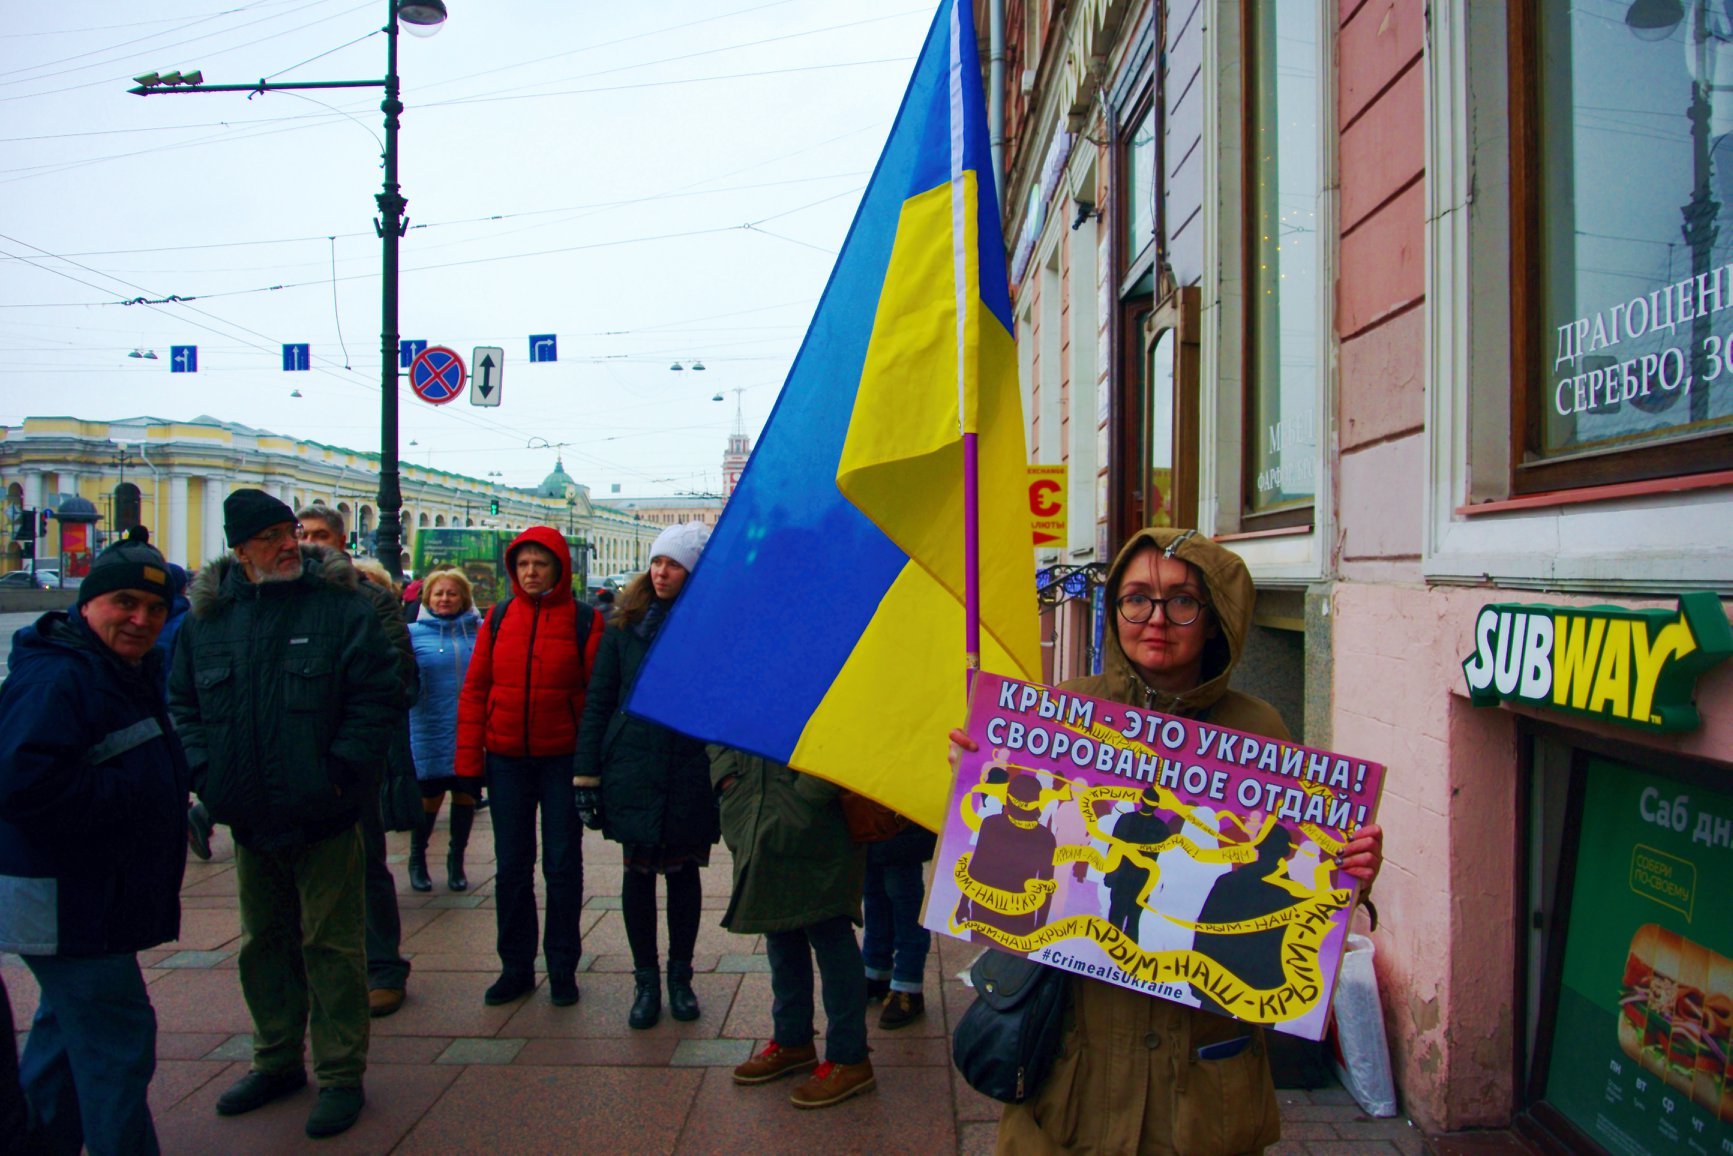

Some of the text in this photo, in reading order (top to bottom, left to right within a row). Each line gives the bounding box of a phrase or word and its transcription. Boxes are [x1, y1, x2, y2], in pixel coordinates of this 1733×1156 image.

[1555, 263, 1733, 371] ДРАГОЦЕН
[1555, 347, 1692, 416] СЕРЕБРО,
[1464, 609, 1697, 723] SUBWAY
[986, 717, 1229, 800] СВОРОВАННОЕ
[1237, 778, 1368, 831] ОТДАЙ!
[998, 680, 1095, 728] КРЫМ
[1121, 711, 1186, 749] ЭТО
[1196, 727, 1368, 793] УКРАИНА!
[1640, 786, 1733, 850] Саб дн
[1042, 948, 1183, 999] #CrimeaIsUkraine
